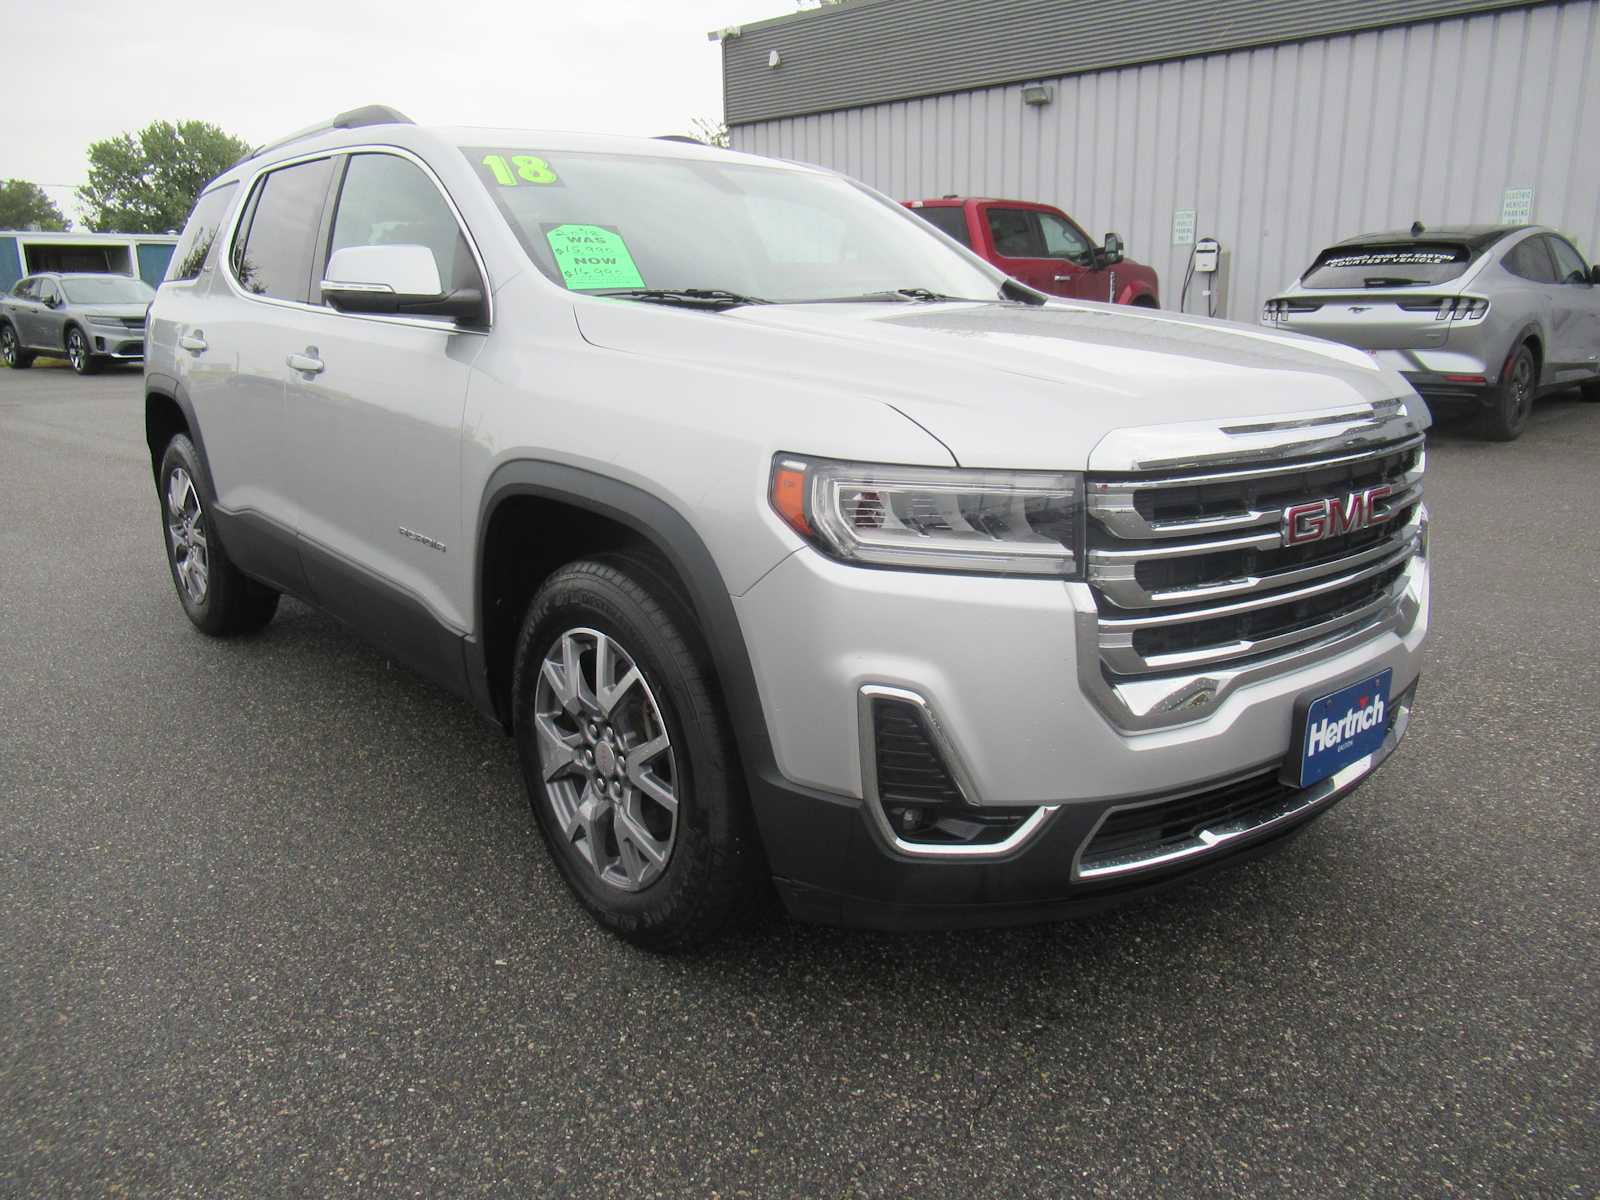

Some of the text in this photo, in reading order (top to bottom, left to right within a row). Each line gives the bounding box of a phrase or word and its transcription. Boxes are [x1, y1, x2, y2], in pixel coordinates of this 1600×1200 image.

[480, 154, 559, 186] 18
[1504, 209, 1528, 217] PARKING
[566, 236, 607, 244] WAS
[574, 257, 617, 265] NOW
[1330, 256, 1442, 267] COURTESY VEHICLE
[1413, 253, 1456, 261] EASTON
[1283, 485, 1393, 548] GMC
[1307, 693, 1385, 758] Hertrich
